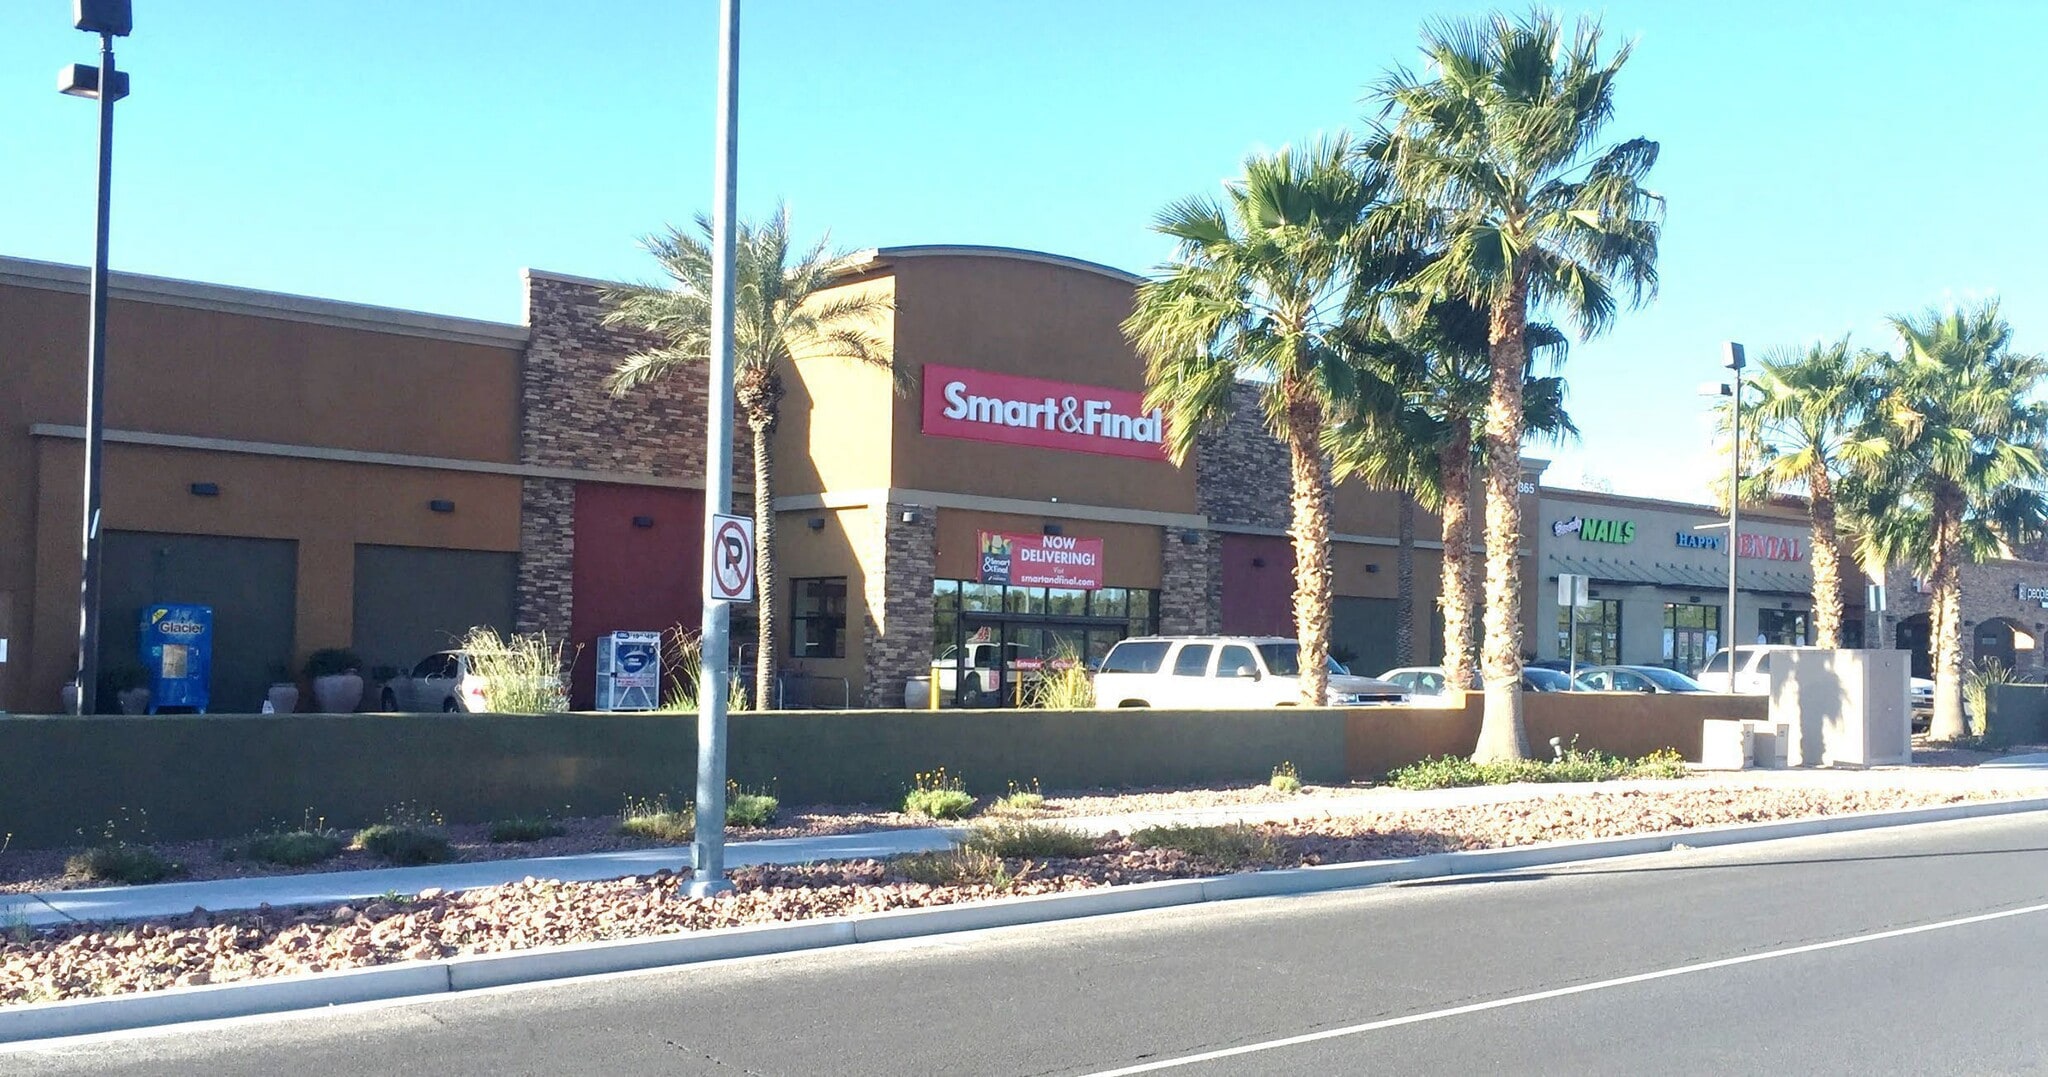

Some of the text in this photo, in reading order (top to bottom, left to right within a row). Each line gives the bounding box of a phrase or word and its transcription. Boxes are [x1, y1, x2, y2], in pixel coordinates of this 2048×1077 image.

[1580, 518, 1635, 544] NAILS
[1042, 535, 1077, 550] NOW
[1677, 531, 1804, 561] HAPPY ENTAL
[1021, 549, 1096, 566] DELIVERING!
[1021, 574, 1095, 587] smartandfinal.com
[160, 621, 204, 634] Glacier
